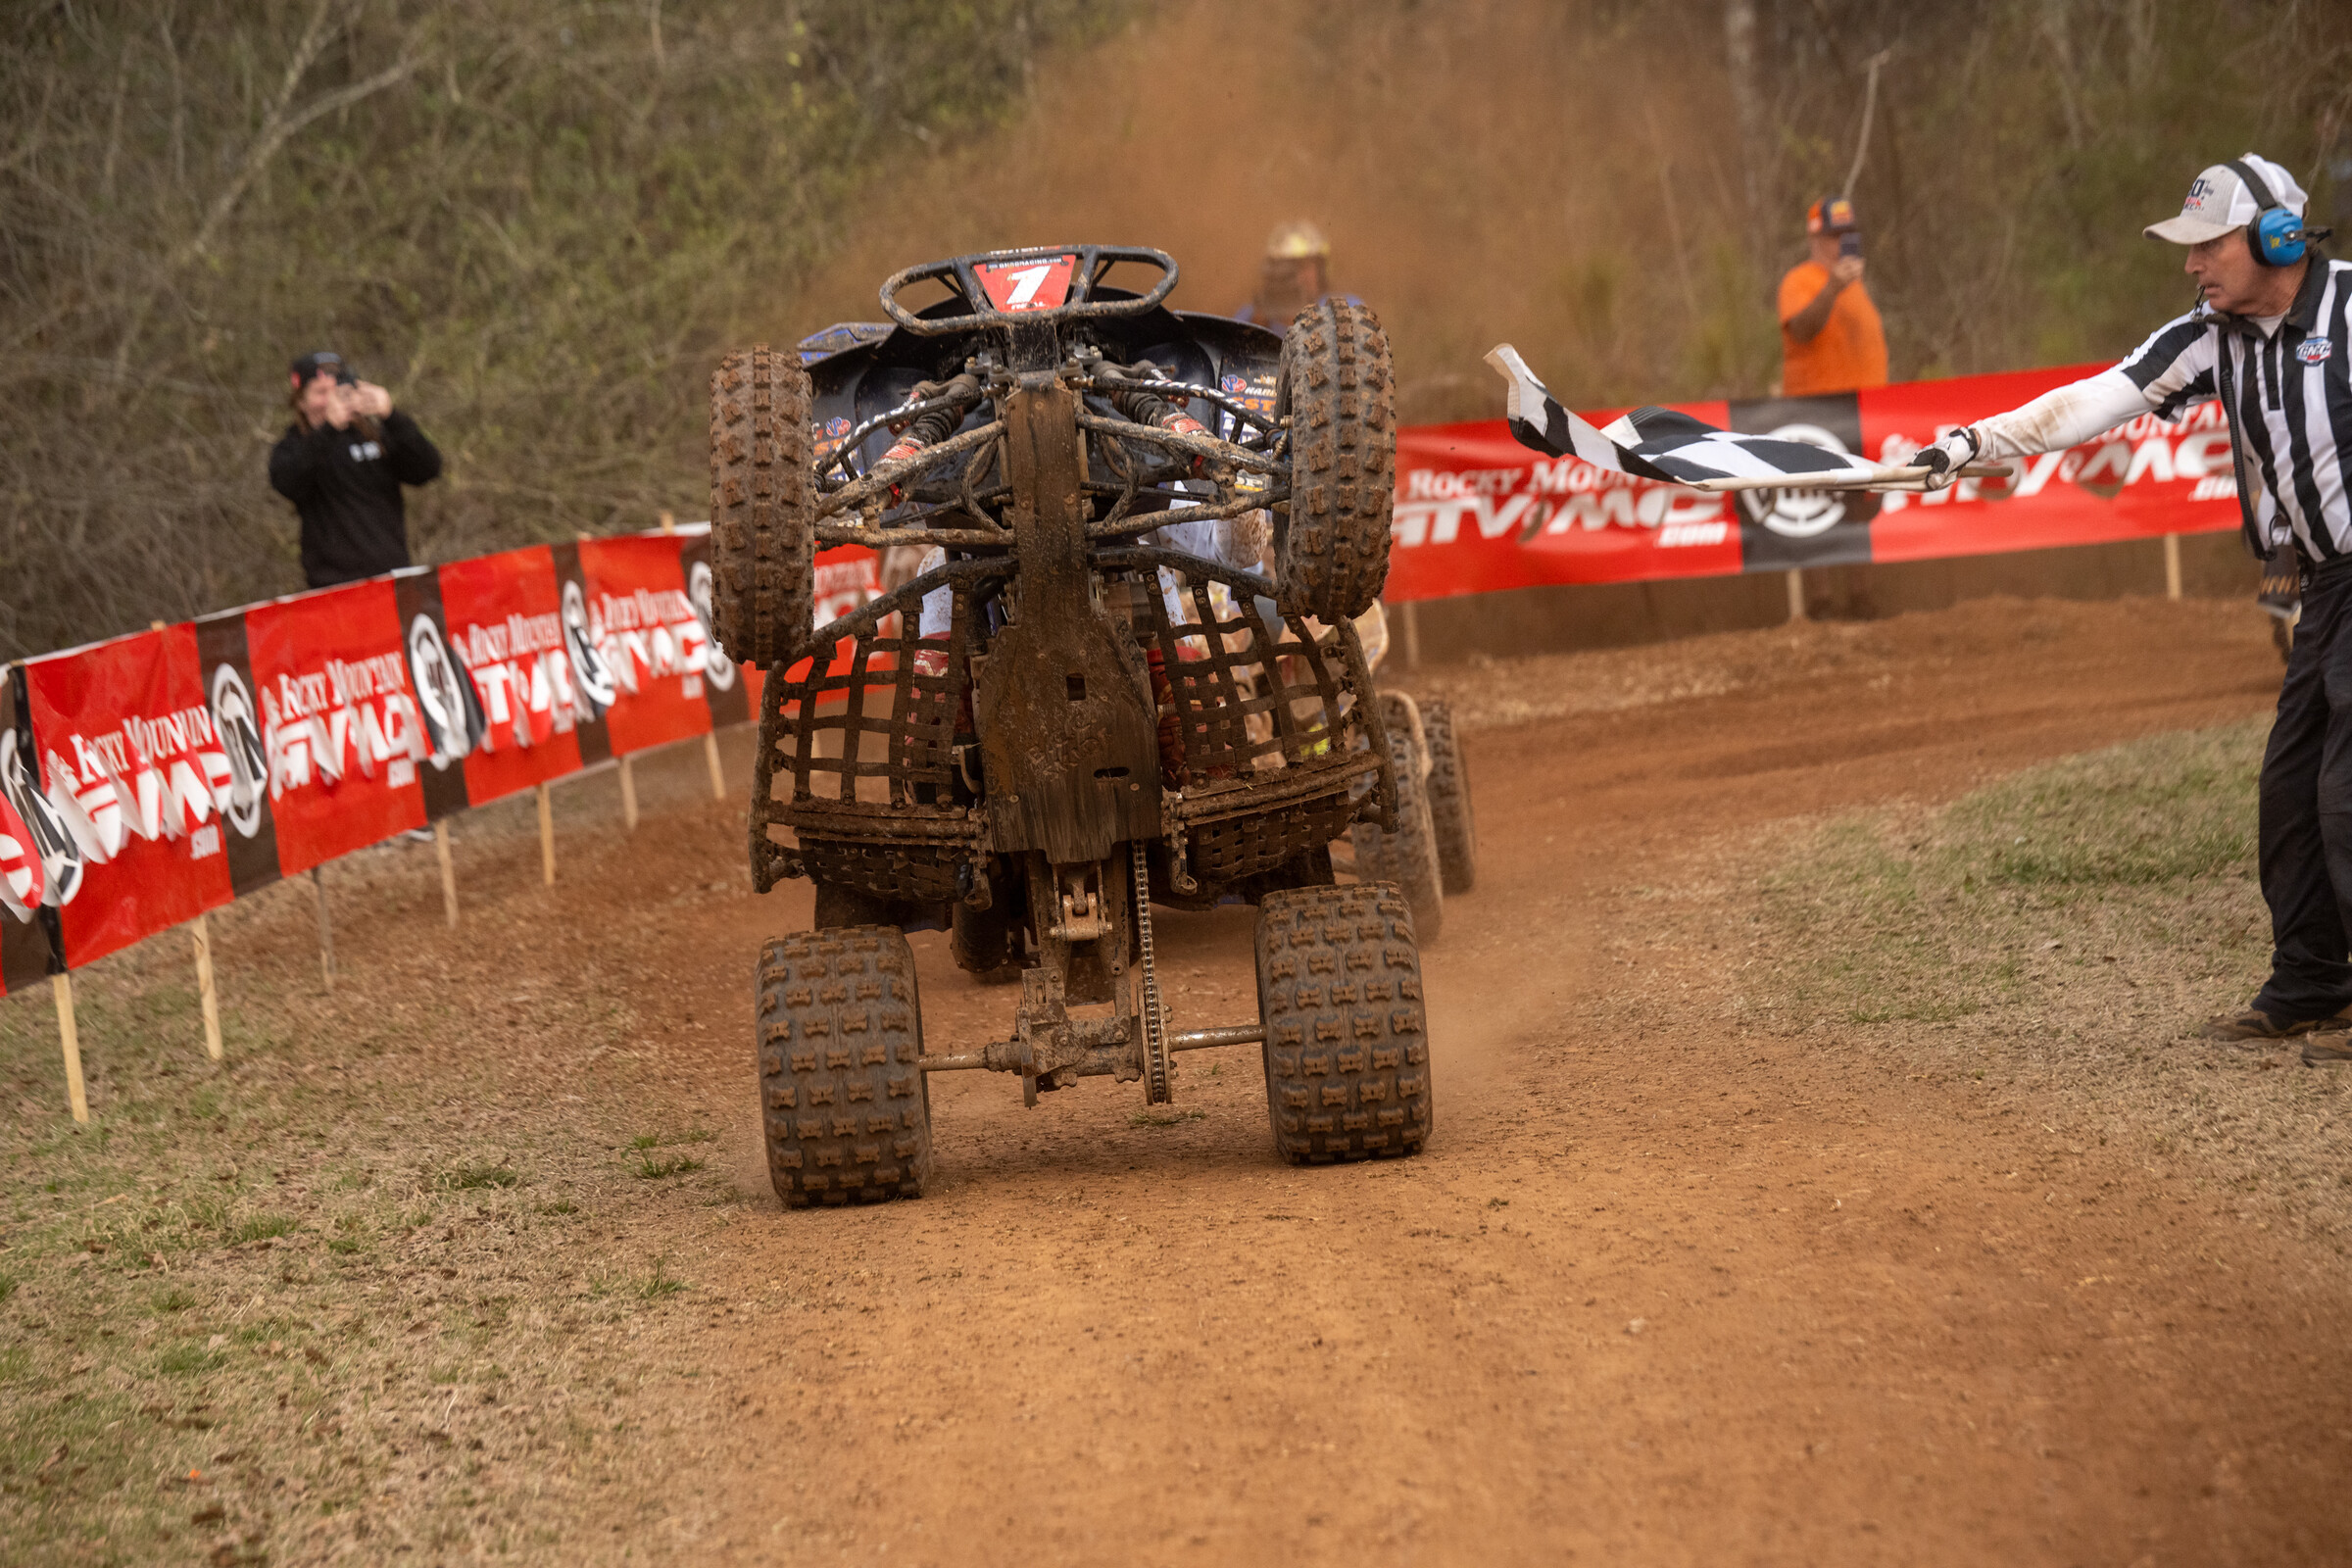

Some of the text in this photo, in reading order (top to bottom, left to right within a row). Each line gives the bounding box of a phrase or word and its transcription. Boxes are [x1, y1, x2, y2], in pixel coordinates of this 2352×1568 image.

[1005, 265, 1053, 306] 1
[1406, 467, 1525, 499] ROCKY
[69, 730, 131, 785] RKY
